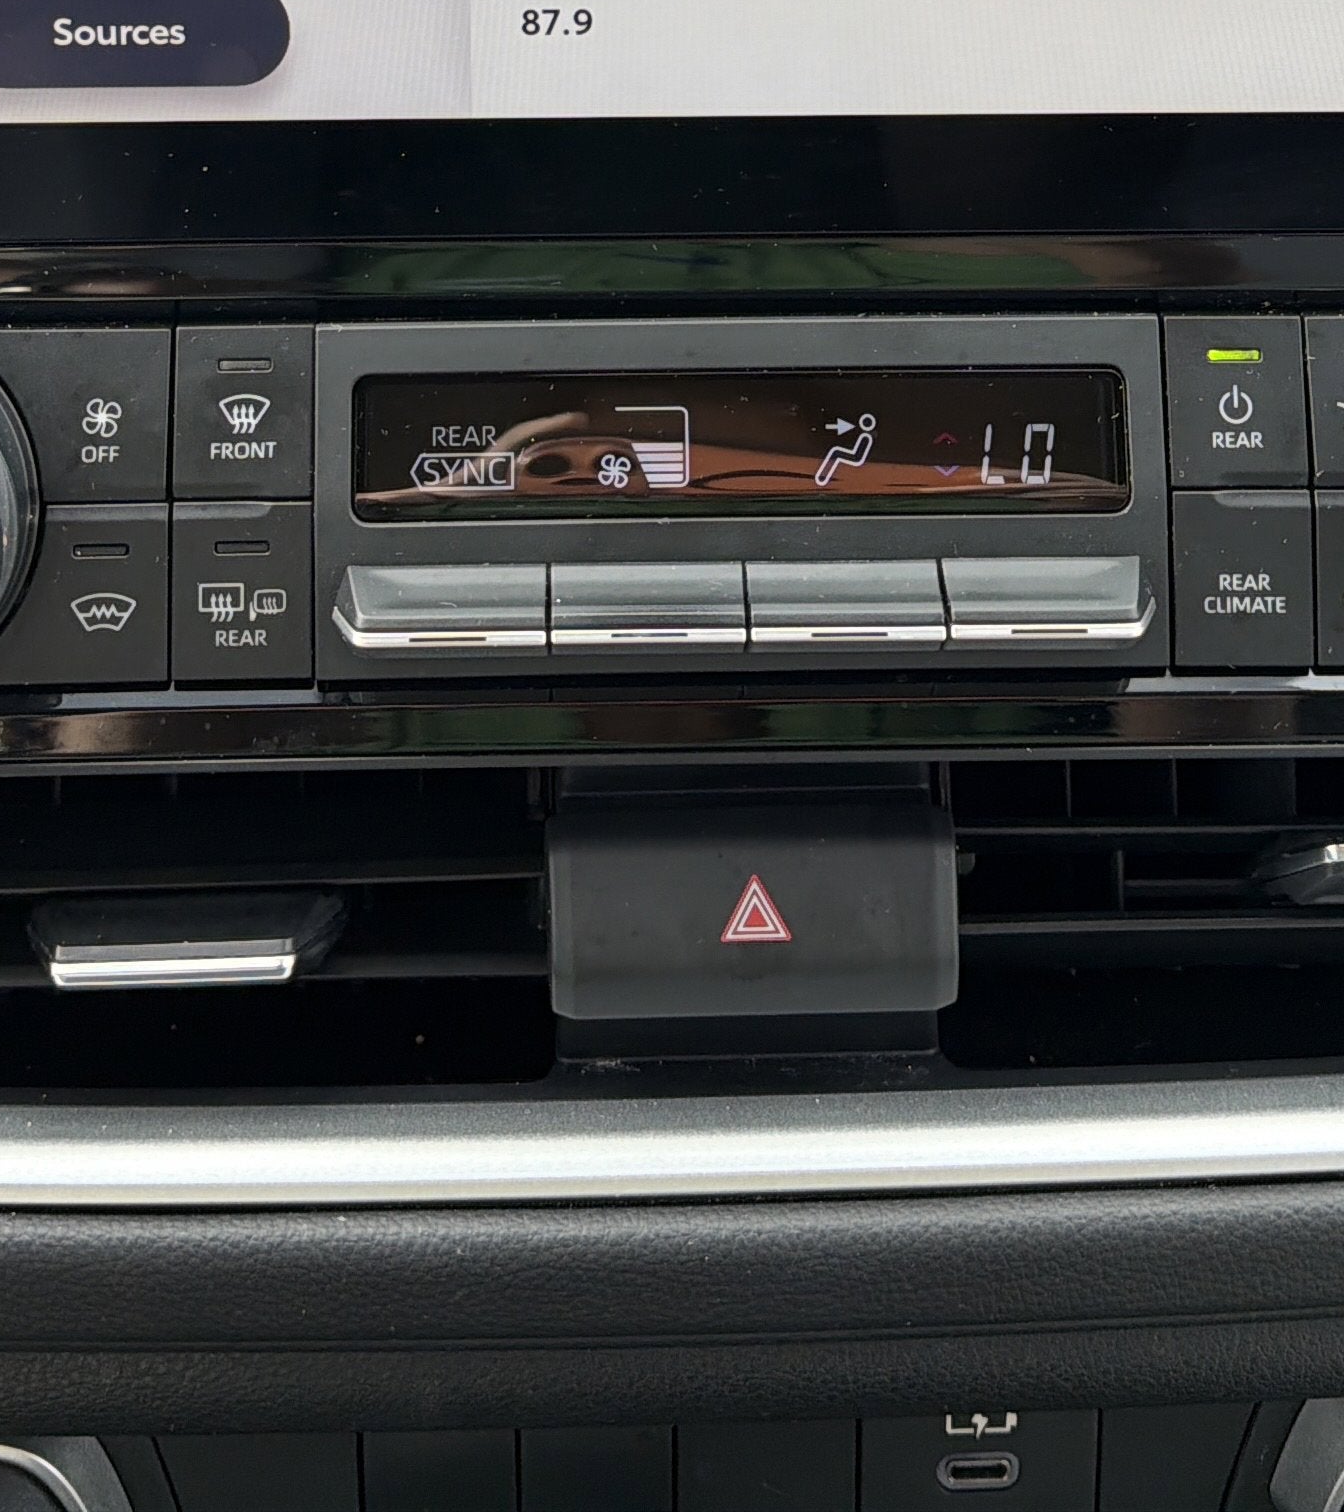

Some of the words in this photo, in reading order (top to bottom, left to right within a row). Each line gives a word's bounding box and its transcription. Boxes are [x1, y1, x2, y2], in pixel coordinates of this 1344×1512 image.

[53, 17, 186, 46] Sources
[521, 8, 593, 37] 87.9
[431, 426, 497, 447] REAR
[1211, 431, 1264, 449] REAR
[81, 445, 121, 464] OFF
[210, 441, 277, 460] FRONT
[422, 458, 509, 486] SYNC
[1218, 573, 1272, 592] REAR
[1203, 595, 1288, 615] CLIMATE
[214, 629, 269, 648] REAR
